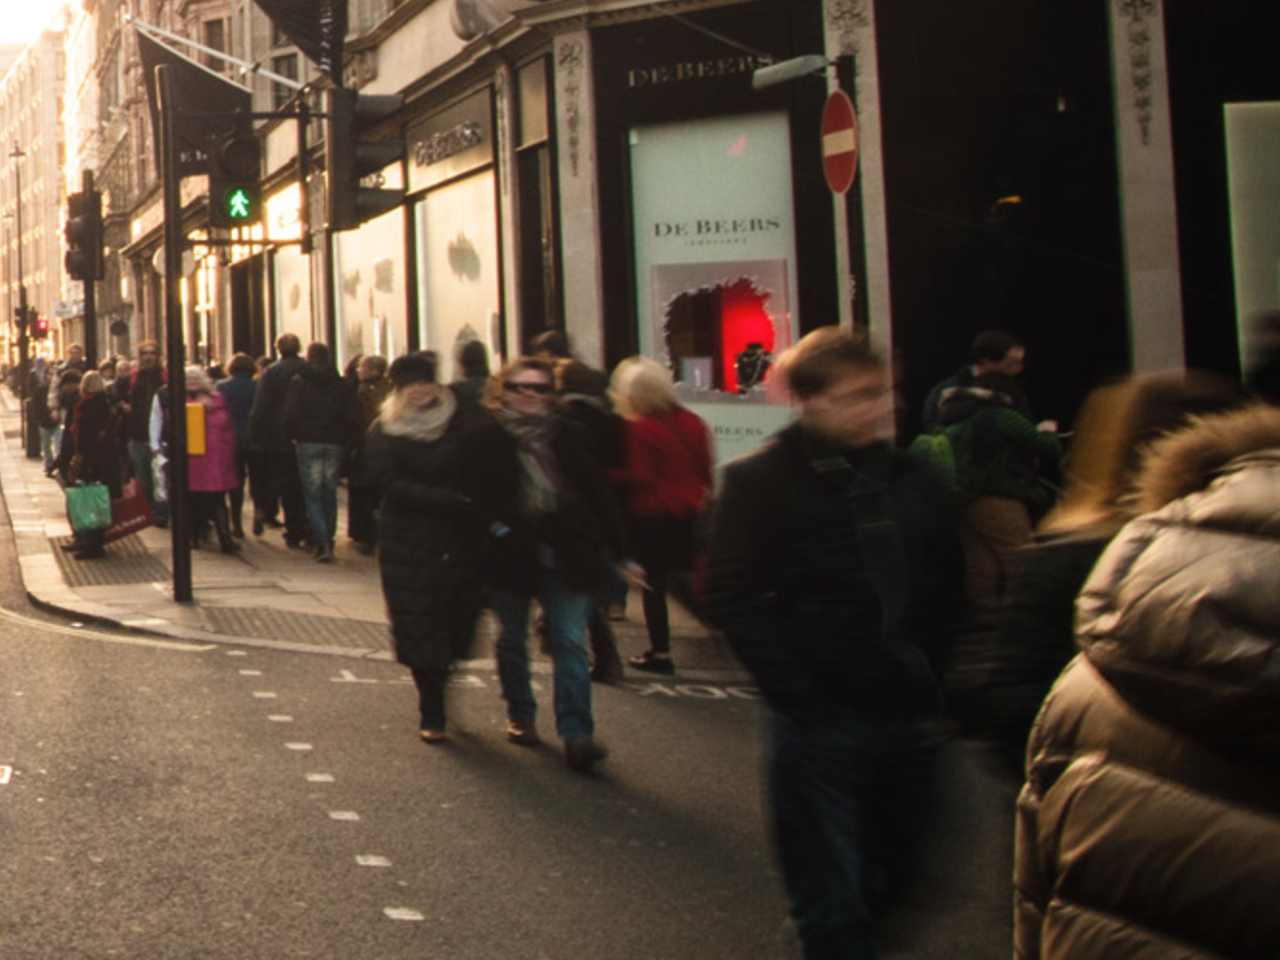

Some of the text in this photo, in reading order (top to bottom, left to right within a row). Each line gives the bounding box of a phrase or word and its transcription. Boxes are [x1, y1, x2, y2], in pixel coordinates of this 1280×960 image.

[628, 66, 668, 87] DE
[655, 219, 781, 237] DE BEERS
